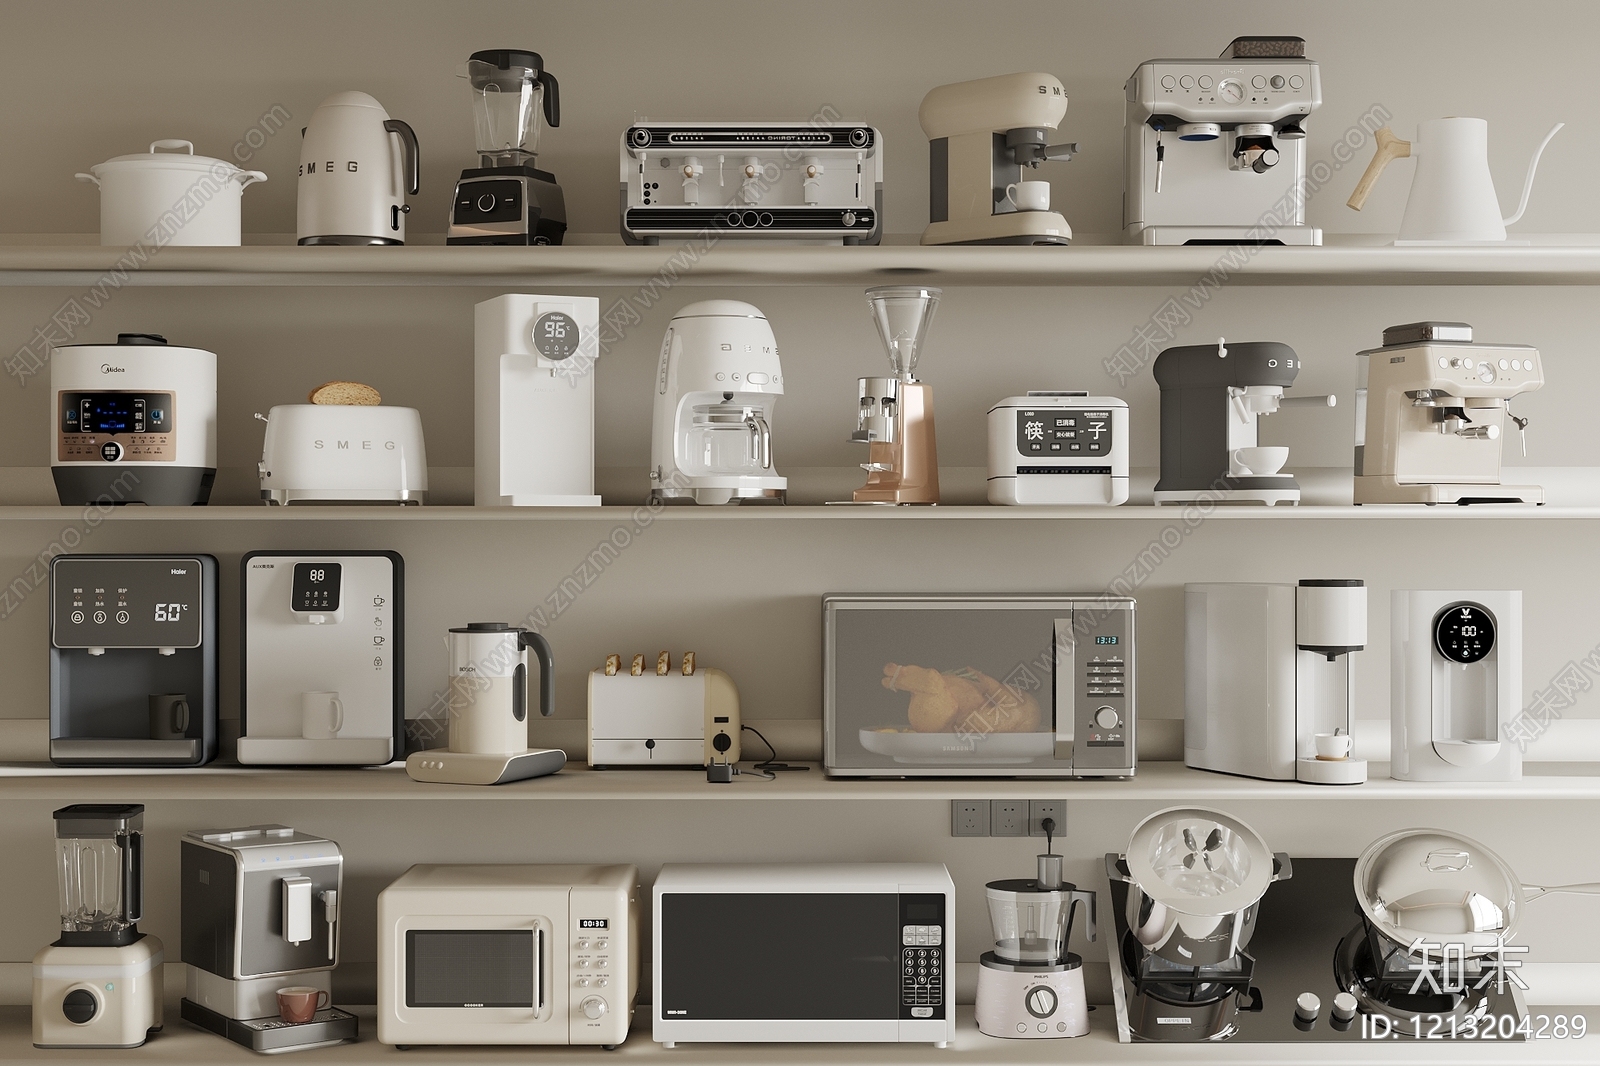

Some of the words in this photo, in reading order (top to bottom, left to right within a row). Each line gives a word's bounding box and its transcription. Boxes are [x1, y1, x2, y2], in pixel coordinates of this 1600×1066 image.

[299, 161, 358, 177] SMEG
[101, 363, 126, 374] Midea
[1025, 421, 1044, 441] 筷
[1088, 421, 1107, 440] 子
[314, 439, 396, 451] SMEG
[310, 570, 325, 581] 88
[583, 920, 604, 928] 00:30
